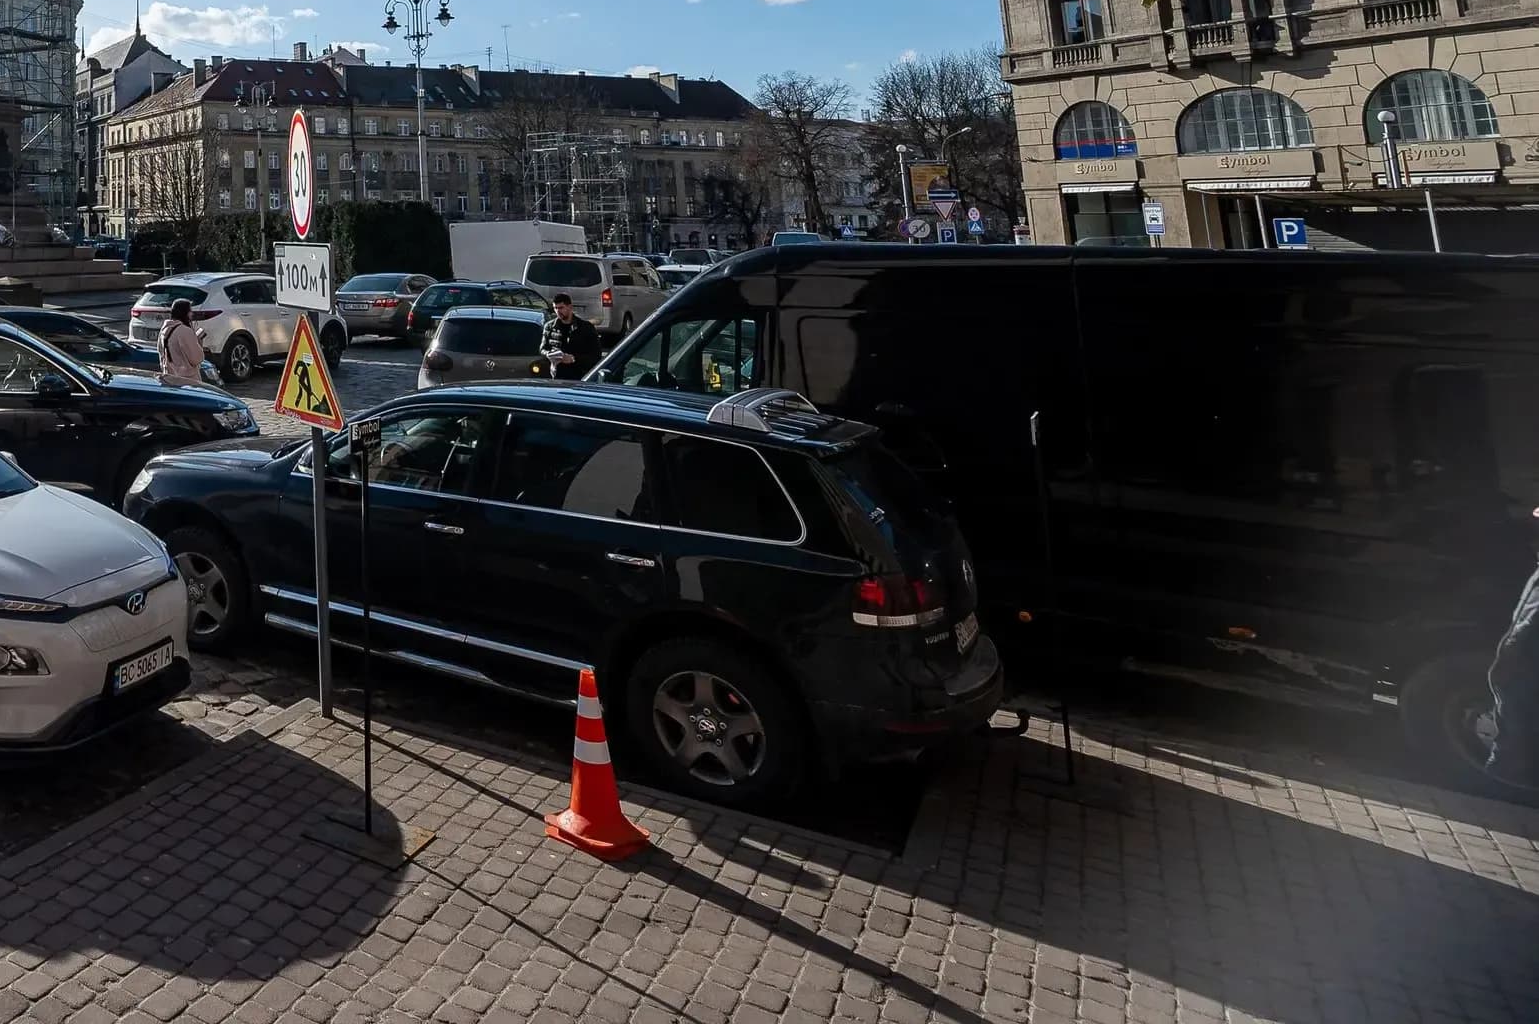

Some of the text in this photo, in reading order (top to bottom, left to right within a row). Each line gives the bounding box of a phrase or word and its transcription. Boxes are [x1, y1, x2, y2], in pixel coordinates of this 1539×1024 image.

[293, 150, 307, 198] 30
[944, 230, 952, 241] P
[1281, 221, 1299, 243] P
[121, 664, 135, 684] BC
[137, 653, 158, 677] 5065
